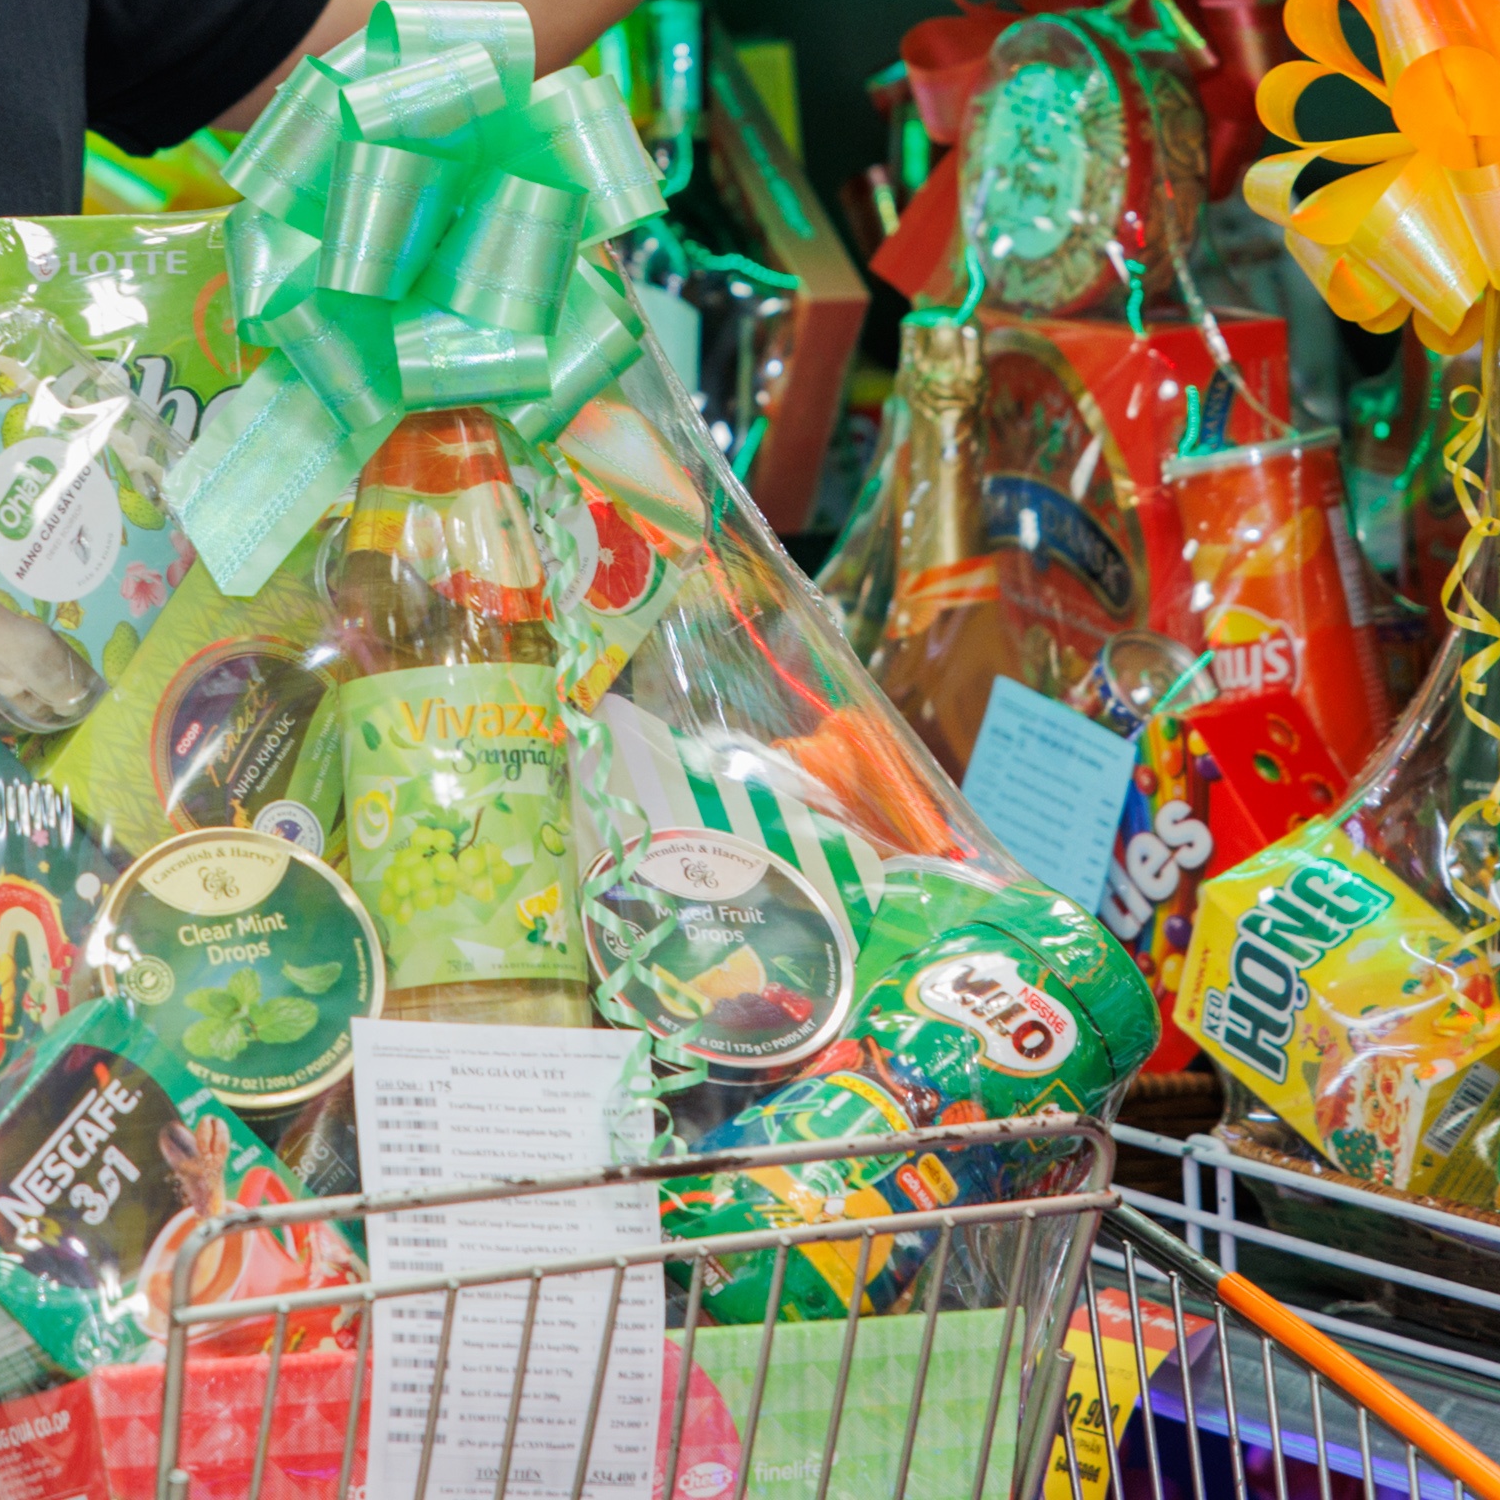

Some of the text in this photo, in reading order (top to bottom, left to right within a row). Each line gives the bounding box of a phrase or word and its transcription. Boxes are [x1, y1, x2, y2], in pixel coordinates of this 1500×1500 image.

[67, 250, 188, 277] LOTTE
[175, 722, 202, 756] COOP
[233, 711, 297, 800] NHO KHÔ ÚC
[452, 733, 550, 783] Sangria
[150, 845, 277, 886] Cavendish & Harvey
[638, 843, 757, 871] avendish & Harvey
[177, 910, 289, 948] Clear Mint
[653, 903, 767, 926] Mxed Fruit
[684, 922, 745, 947] Drops
[205, 939, 271, 968] Drops
[1018, 986, 1069, 1035] Nestlé
[657, 1013, 678, 1032] NET
[771, 1030, 803, 1052] POIDS
[796, 1017, 818, 1037] NET
[305, 1049, 336, 1078] POIDS
[429, 1080, 452, 1093] 175
[33, 1409, 71, 1440] CO.OP
[752, 1452, 826, 1484] finelife
